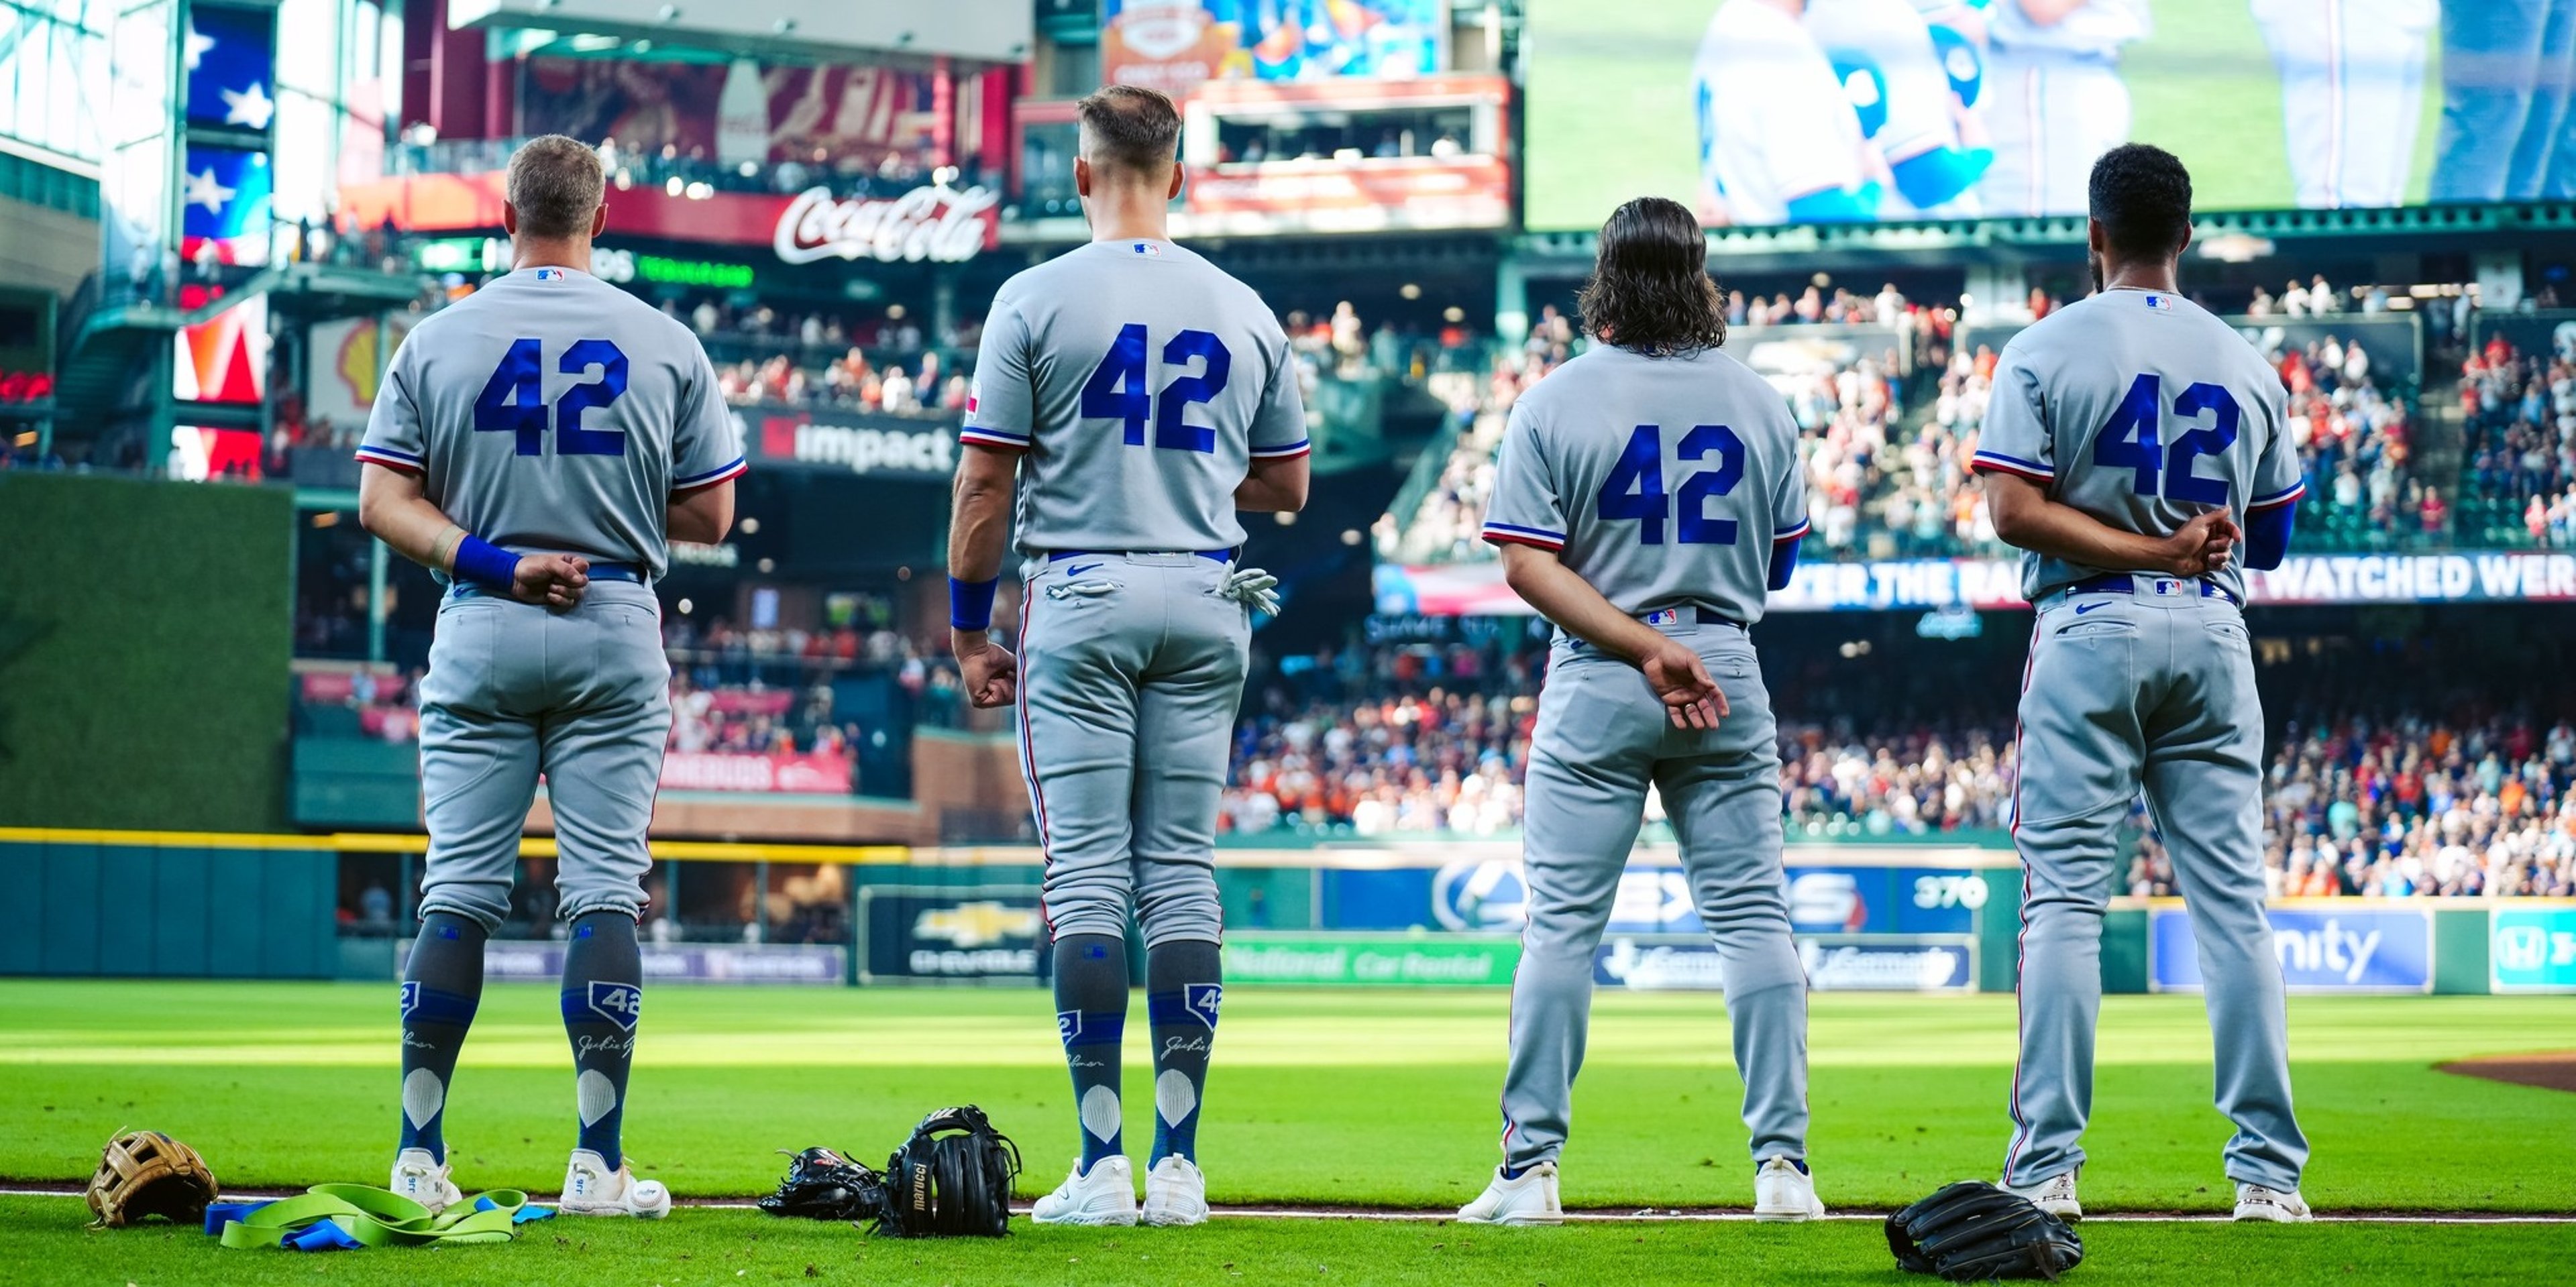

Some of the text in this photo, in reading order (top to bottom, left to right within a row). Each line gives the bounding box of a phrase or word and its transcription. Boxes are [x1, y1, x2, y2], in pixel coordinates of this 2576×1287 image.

[474, 338, 629, 459] 42
[1080, 323, 1232, 454] 42
[794, 412, 955, 475] impact
[2093, 373, 2241, 506] 42
[1597, 425, 1746, 547] 42
[1870, 561, 1954, 606] THE
[2265, 555, 2471, 599] WATCHED
[1913, 875, 1989, 909] 370
[1228, 946, 1347, 978] National
[1354, 951, 1399, 978] Car
[2273, 918, 2381, 984] nity
[914, 1162, 926, 1211] marucci
